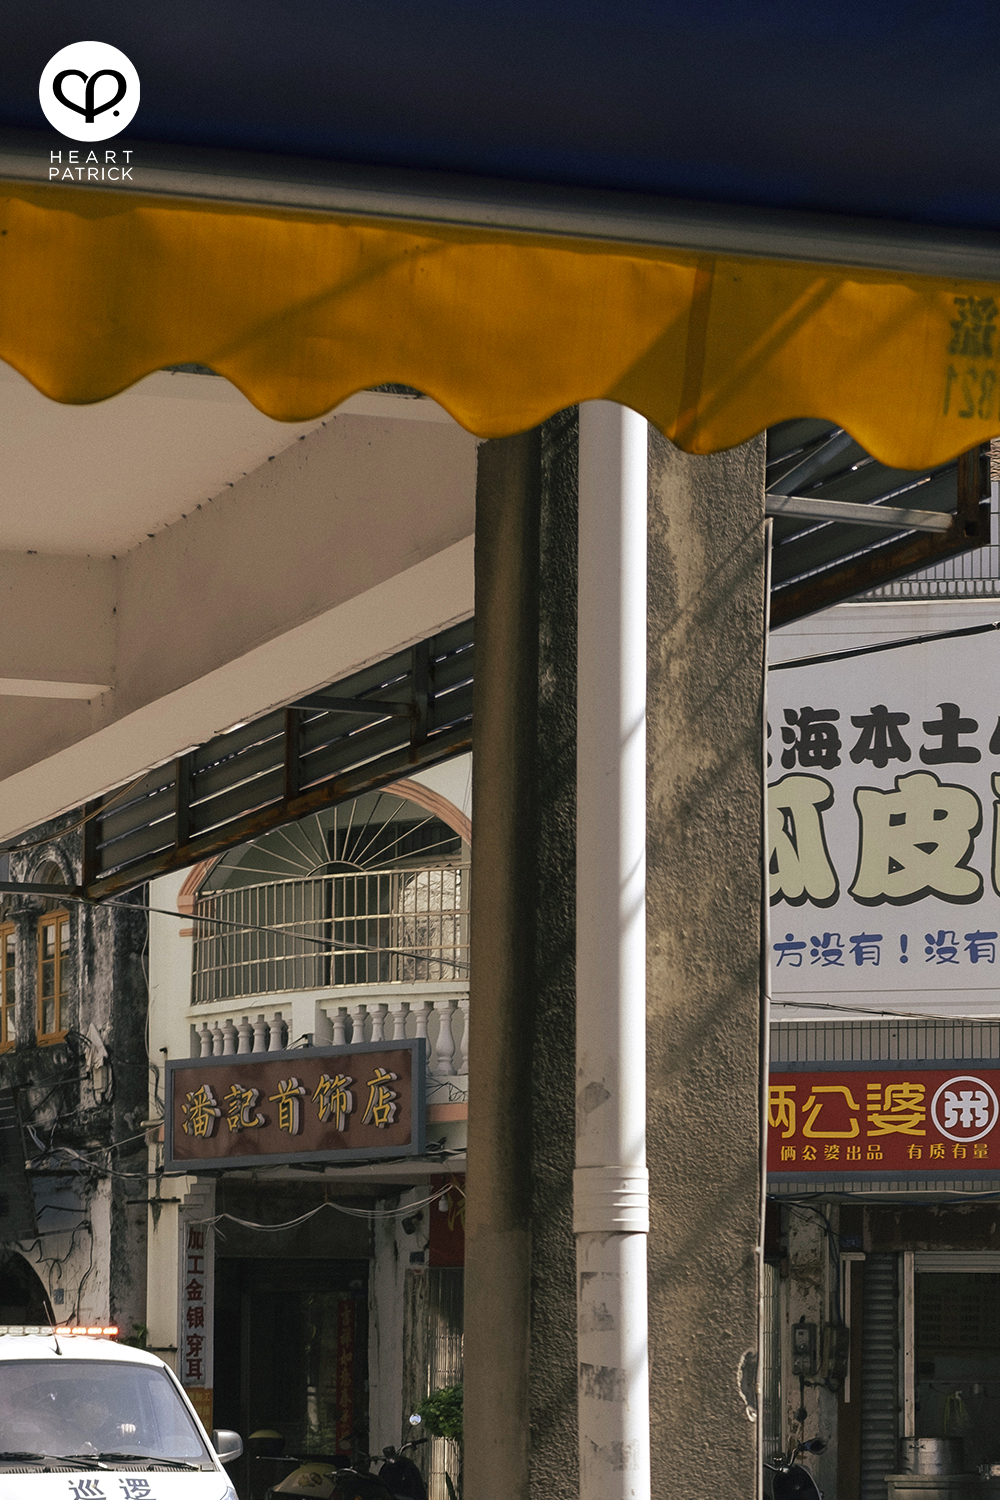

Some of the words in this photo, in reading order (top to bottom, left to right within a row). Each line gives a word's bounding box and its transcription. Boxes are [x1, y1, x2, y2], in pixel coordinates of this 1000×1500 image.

[780, 1144, 884, 1161] 俩公婆出品
[907, 1143, 990, 1160] 有质有量
[185, 1226, 205, 1381] 加工金银穿耳
